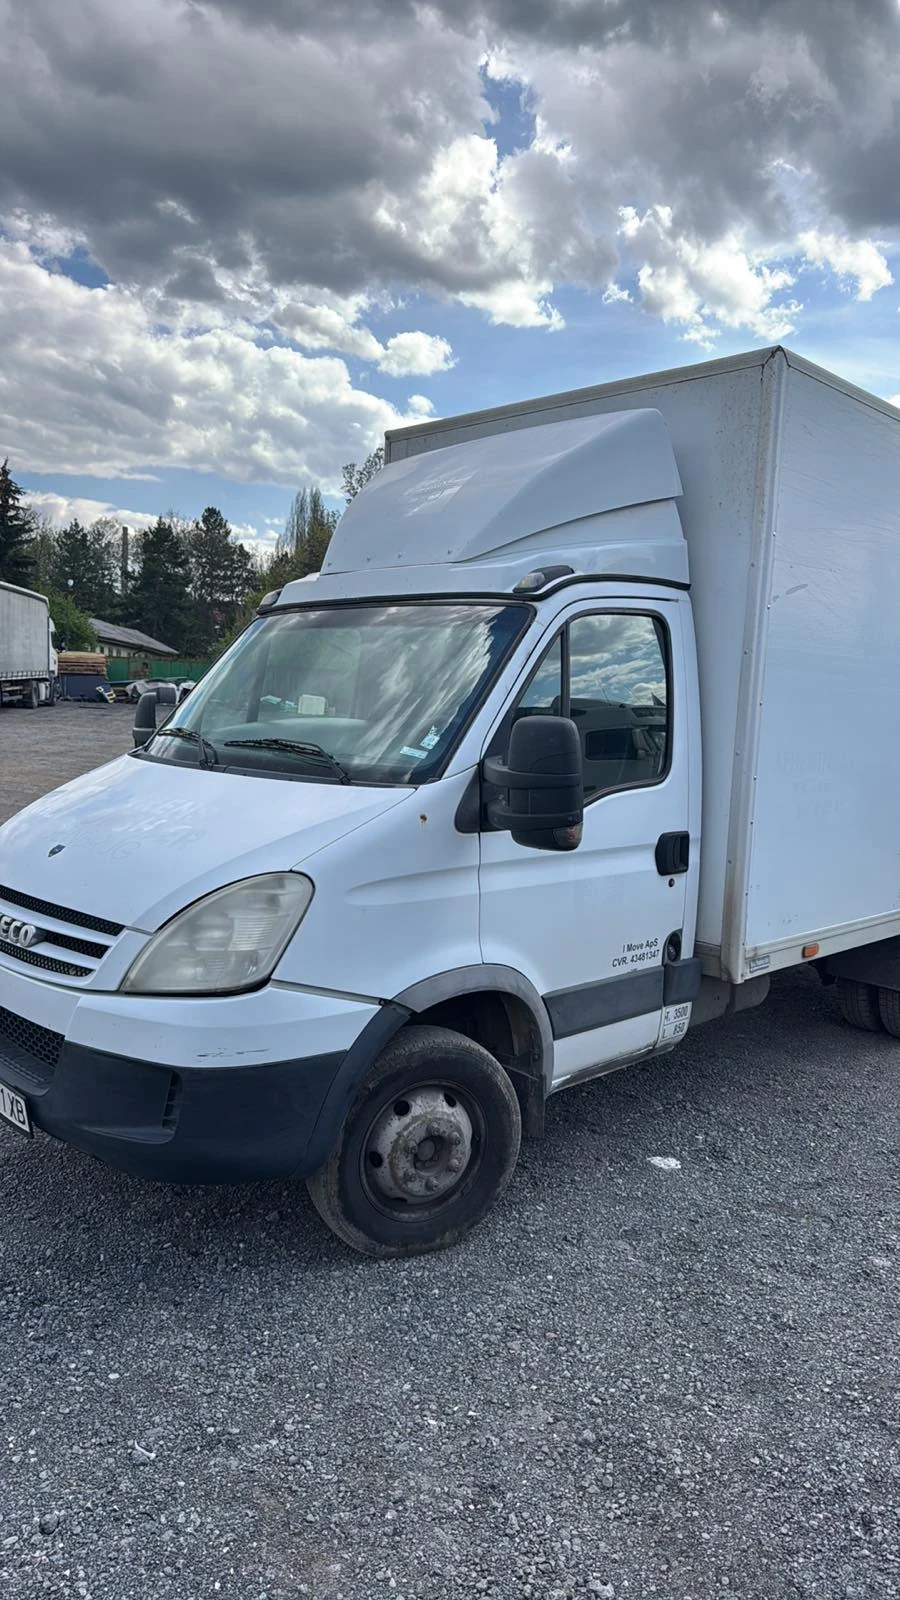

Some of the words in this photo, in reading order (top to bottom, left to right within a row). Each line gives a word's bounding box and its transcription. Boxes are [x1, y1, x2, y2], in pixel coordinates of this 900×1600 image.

[627, 942, 644, 952] Move
[645, 938, 658, 949] ApS
[631, 949, 660, 963] 43481347
[674, 1005, 688, 1019] 3500
